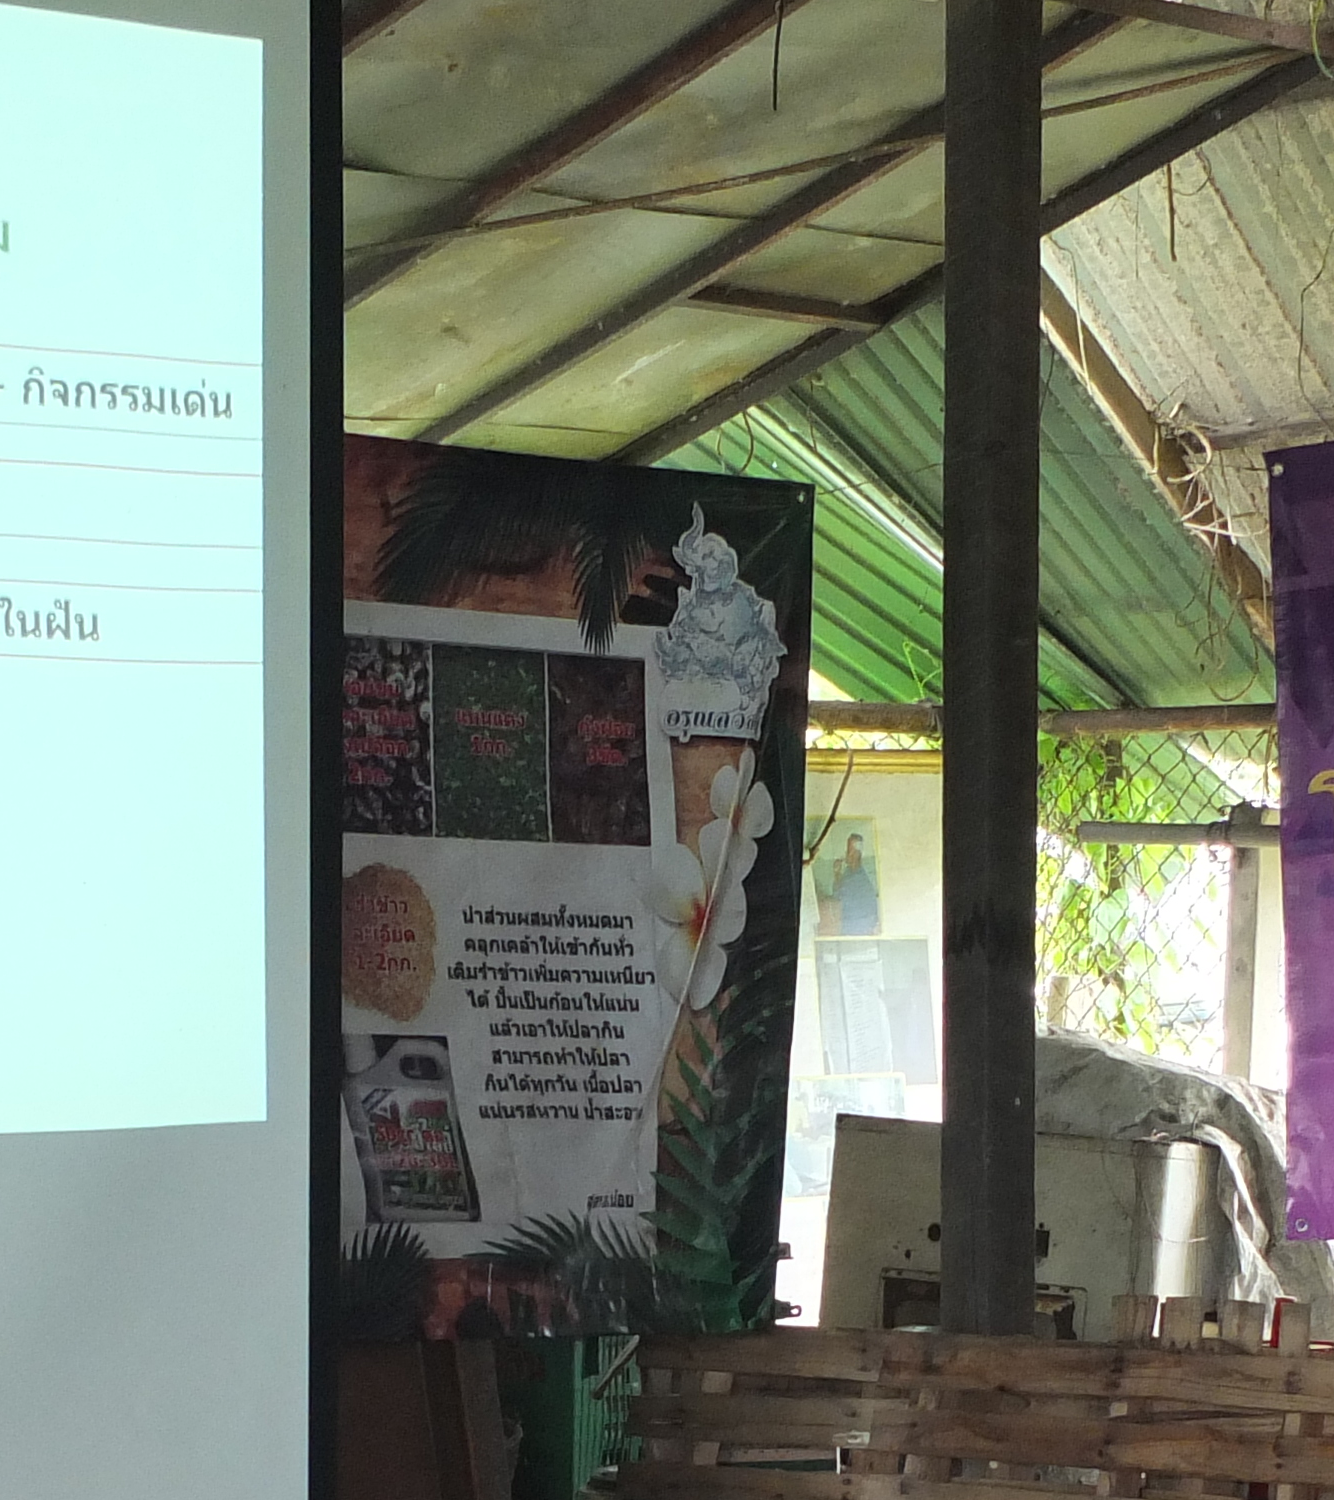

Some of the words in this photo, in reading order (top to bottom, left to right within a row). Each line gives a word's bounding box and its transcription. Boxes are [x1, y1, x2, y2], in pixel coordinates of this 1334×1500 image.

[22, 368, 233, 420] กิจกรรมเด่น
